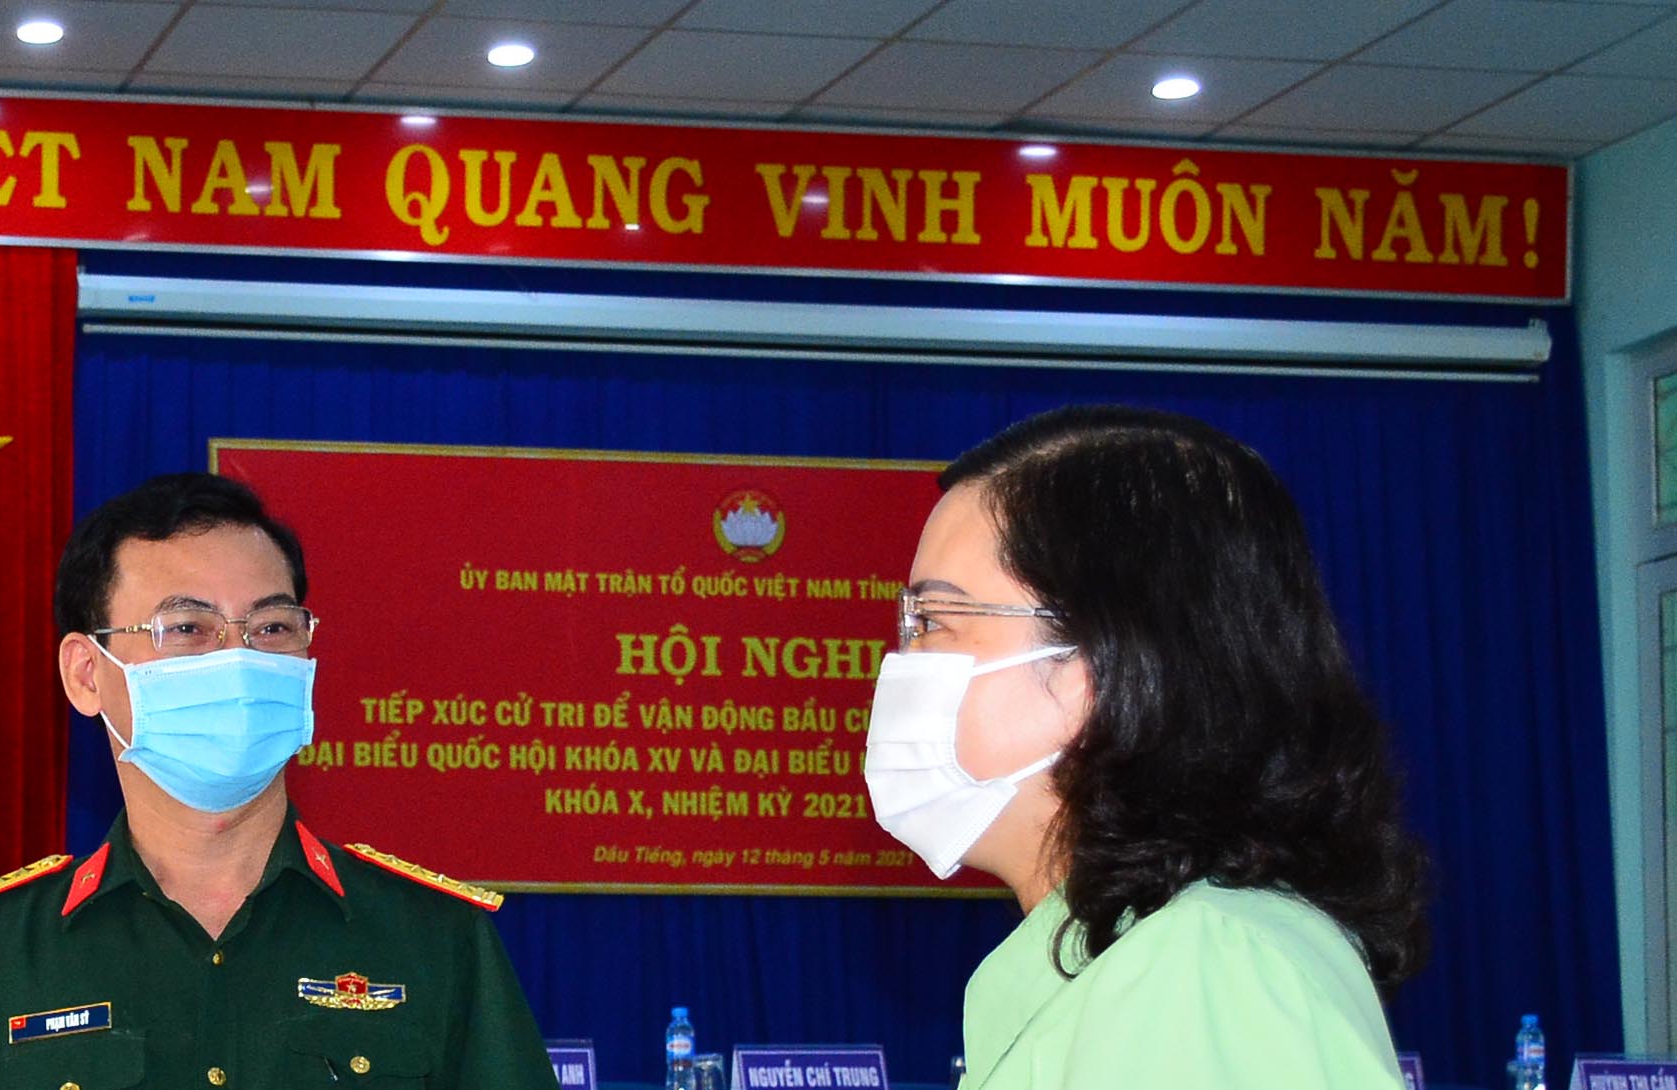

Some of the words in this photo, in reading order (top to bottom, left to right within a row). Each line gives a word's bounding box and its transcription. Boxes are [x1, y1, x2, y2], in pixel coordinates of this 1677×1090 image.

[126, 135, 342, 219] NAM
[385, 144, 710, 246] QUANG
[756, 163, 981, 245] VINH
[1025, 158, 1273, 257] MUÔN
[1313, 168, 1539, 269] NĂM!
[495, 569, 538, 591] BAN
[596, 568, 652, 598] TRẬN
[692, 569, 748, 599] QUỐC
[753, 572, 800, 601] VIỆT
[807, 578, 851, 599] NAM
[616, 623, 722, 686] HỘI
[361, 690, 423, 724] TIẾP
[432, 693, 487, 725] XÚC
[495, 691, 533, 727] CỬ
[540, 702, 584, 727] TRI
[593, 691, 630, 728] ĐỂ
[639, 698, 693, 734] VẬN
[701, 699, 775, 735] ĐỘNG
[298, 741, 344, 771] ĐẠI
[353, 729, 419, 768] BIỂU
[427, 734, 501, 772] QUỐC
[509, 739, 556, 775] HỘI
[565, 740, 639, 772] KHÓA
[647, 748, 683, 772] XV
[689, 741, 725, 773] VÀ
[734, 749, 779, 778] ĐẠI
[788, 738, 851, 775] BIỂU
[545, 782, 619, 815] KHÓA
[628, 790, 653, 819] X,
[662, 785, 749, 821] NHIỆM
[758, 786, 793, 817] KỲ
[803, 793, 868, 818] 2021
[692, 849, 734, 868] ngày
[741, 849, 759, 865] 12
[765, 848, 813, 869] tháng
[833, 850, 871, 866] năm
[833, 1066, 879, 1088] TRUNG
